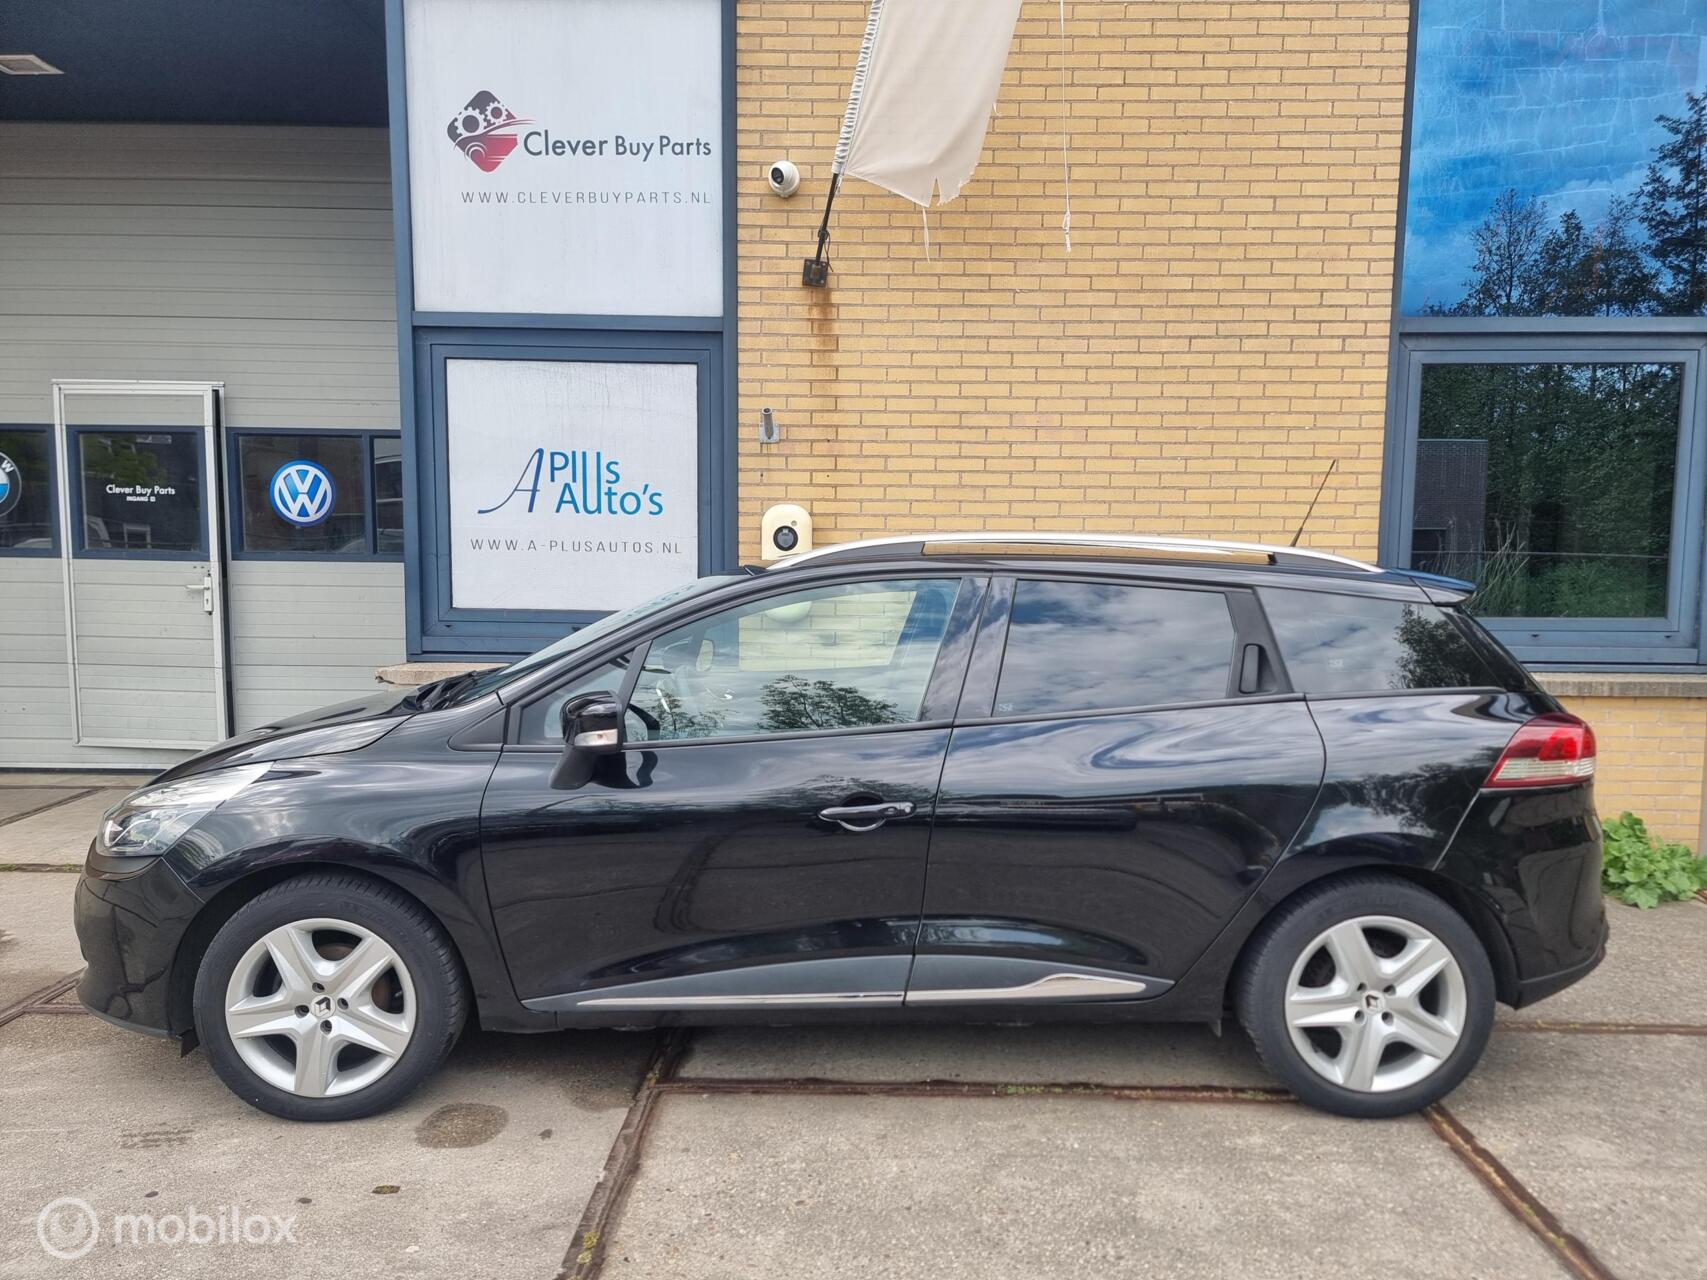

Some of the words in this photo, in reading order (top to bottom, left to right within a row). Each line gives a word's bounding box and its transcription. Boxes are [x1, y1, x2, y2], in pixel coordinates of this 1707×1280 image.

[523, 129, 608, 156] Clever
[615, 135, 655, 162] Buy
[659, 135, 712, 156] Parts
[461, 190, 712, 205] WWW.CLEVERBUYPARTS.NL
[106, 484, 134, 494] Clever
[135, 485, 152, 496] Buy
[154, 485, 176, 495] Parts
[470, 538, 683, 554] WWW.A-PLUSAUTOS.NL
